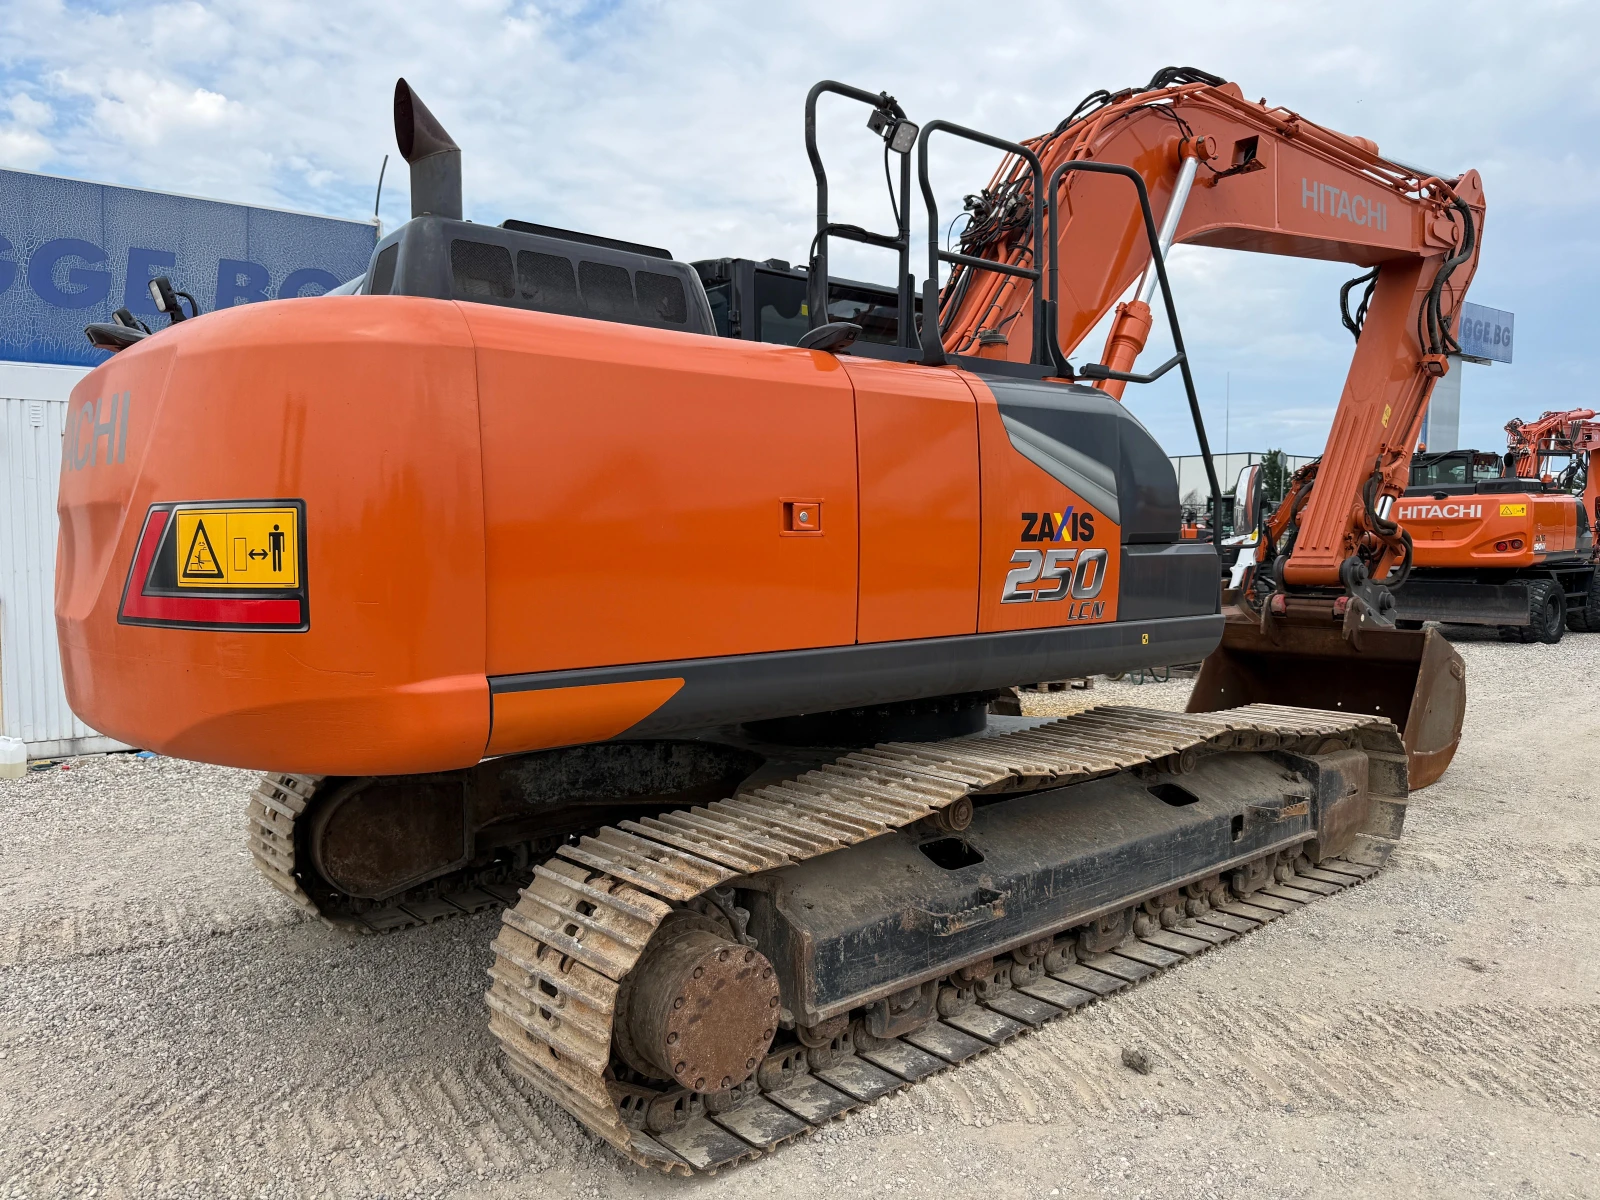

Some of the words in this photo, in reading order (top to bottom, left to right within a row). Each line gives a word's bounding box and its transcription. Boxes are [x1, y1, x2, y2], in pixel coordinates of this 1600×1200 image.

[1301, 177, 1387, 232] HITACHI
[1021, 505, 1095, 542] ZAXIS
[1398, 504, 1482, 520] HITACHI
[1000, 548, 1109, 604] 250
[1067, 600, 1106, 621] LCN
